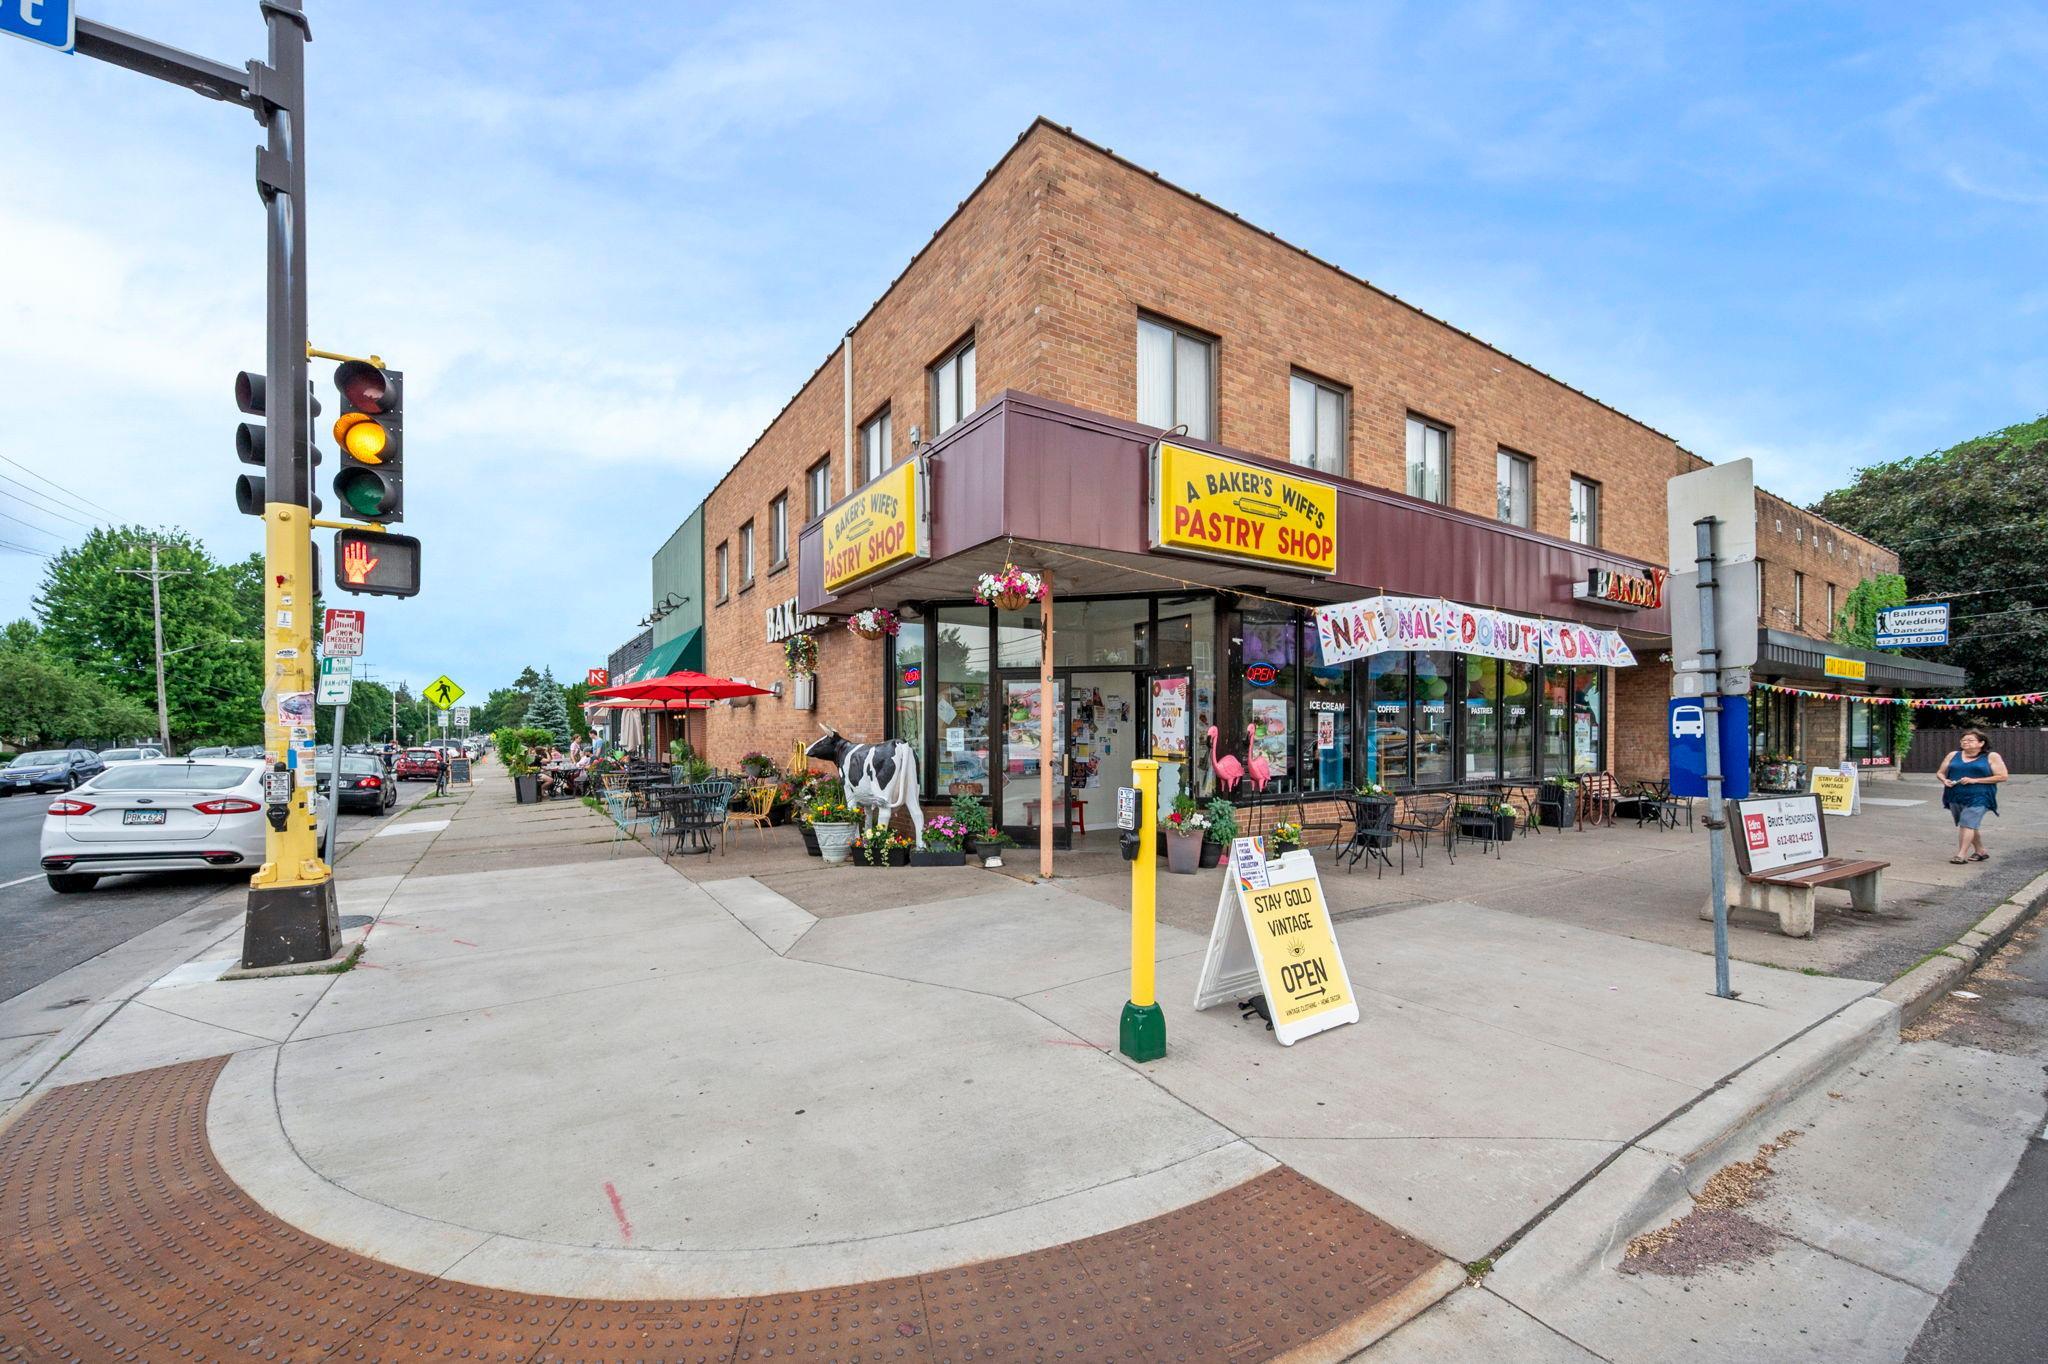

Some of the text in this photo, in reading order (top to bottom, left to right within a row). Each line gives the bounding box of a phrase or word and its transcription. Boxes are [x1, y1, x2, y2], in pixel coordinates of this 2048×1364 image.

[1187, 472, 1325, 529] A BAKER'S WIFE'S
[828, 494, 898, 555] A BAKER'S WIFE'S
[1175, 505, 1333, 561] PASTRY SHOP
[825, 521, 905, 583] PASTRY SHOP
[1596, 566, 1667, 608] BAKERY
[765, 596, 829, 643] BAKE
[1893, 609, 1945, 618] Ballroom
[1894, 618, 1945, 627] Wedding
[1461, 613, 1532, 653] DONUT
[1893, 635, 1944, 644] 371-0300
[1246, 667, 1276, 681] OPEN
[1309, 700, 1345, 712] ICE CREAM
[1377, 705, 1400, 713] COFFEE
[1423, 705, 1445, 713] DONUTS
[1470, 707, 1493, 715] PASTRIES
[1510, 707, 1526, 715] CAKES
[1549, 708, 1564, 716] BREAD
[1156, 707, 1183, 718] DONUT
[456, 716, 469, 725] 25
[1161, 718, 1177, 729] DAY
[1747, 819, 1761, 830] Edina
[1767, 813, 1816, 827] BRUCE HENDRICKSON
[1777, 831, 1813, 845] 612-821-4215
[1254, 887, 1312, 913] STAY GOLD
[1281, 957, 1328, 993] OPEN
